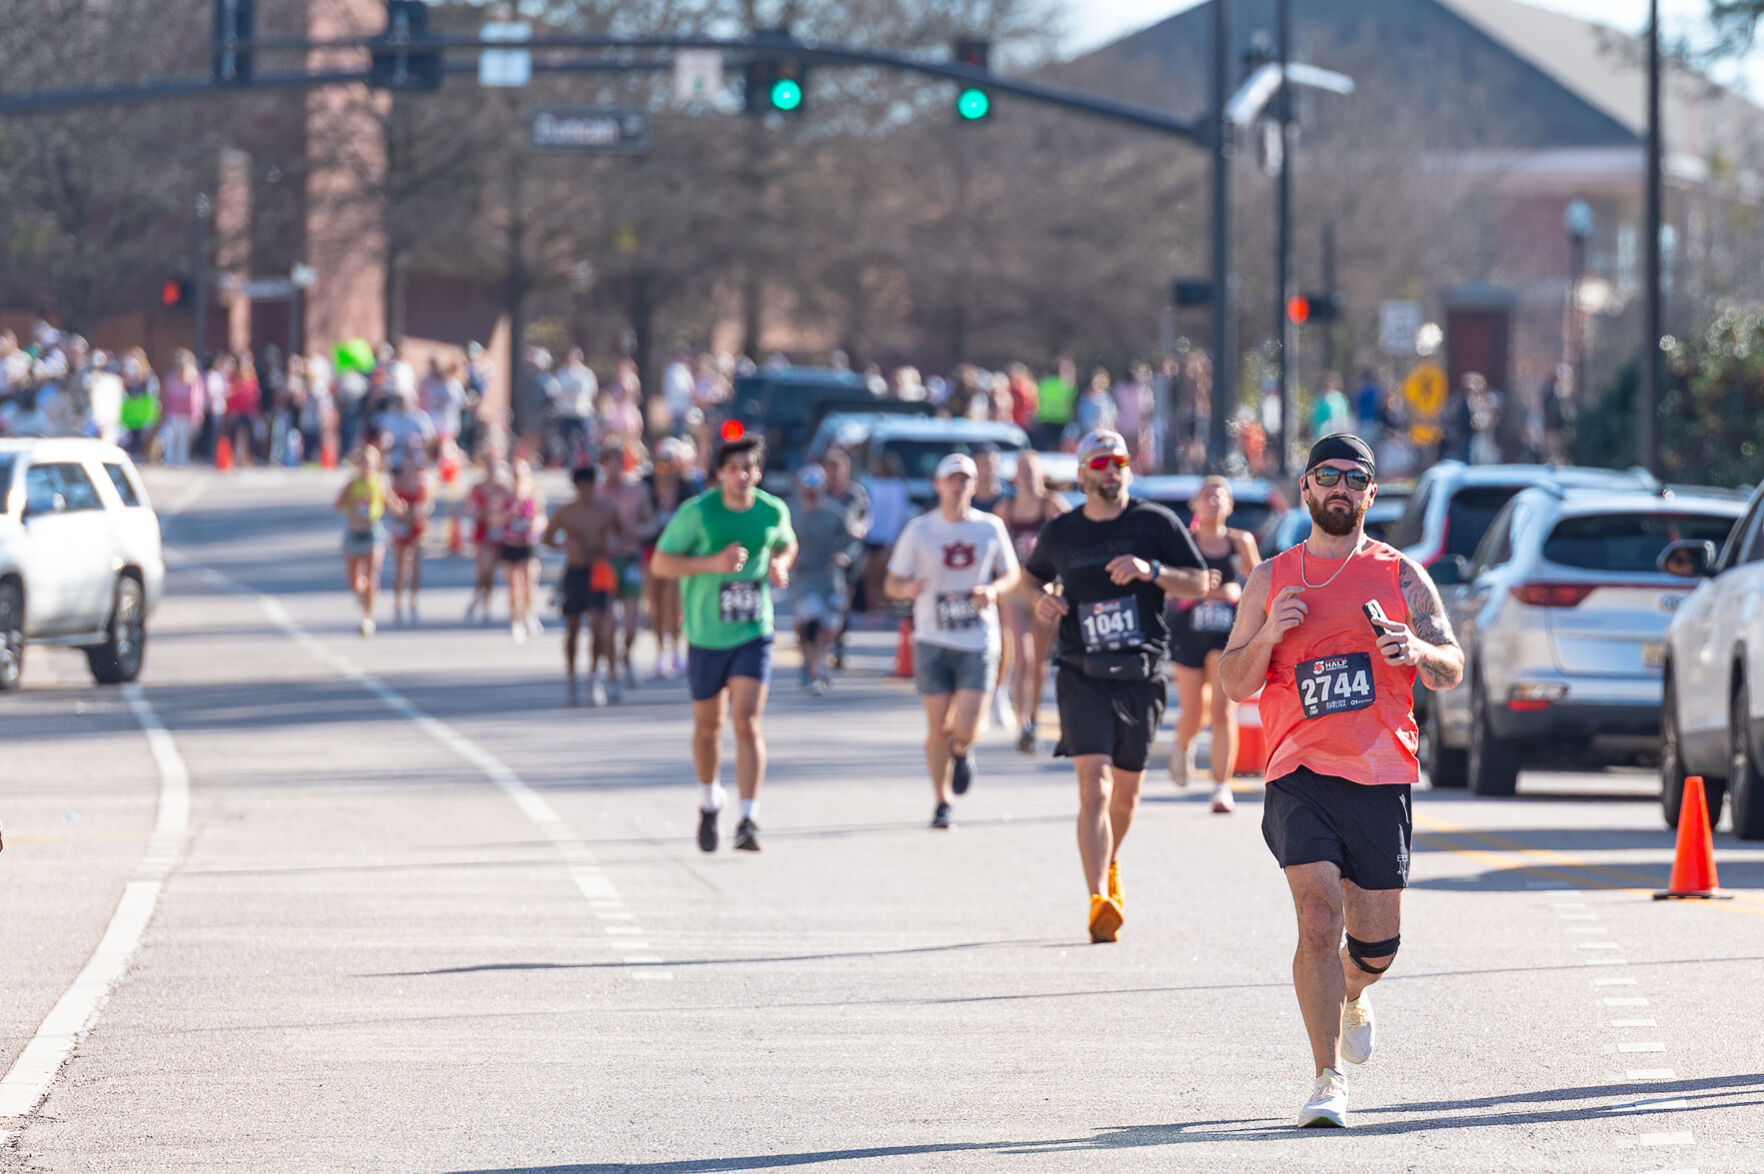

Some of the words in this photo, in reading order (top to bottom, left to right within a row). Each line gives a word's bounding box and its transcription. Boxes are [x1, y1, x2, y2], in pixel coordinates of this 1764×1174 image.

[1083, 609, 1135, 636] 1041
[1325, 659, 1348, 669] HALF
[1301, 669, 1370, 706] 2744
